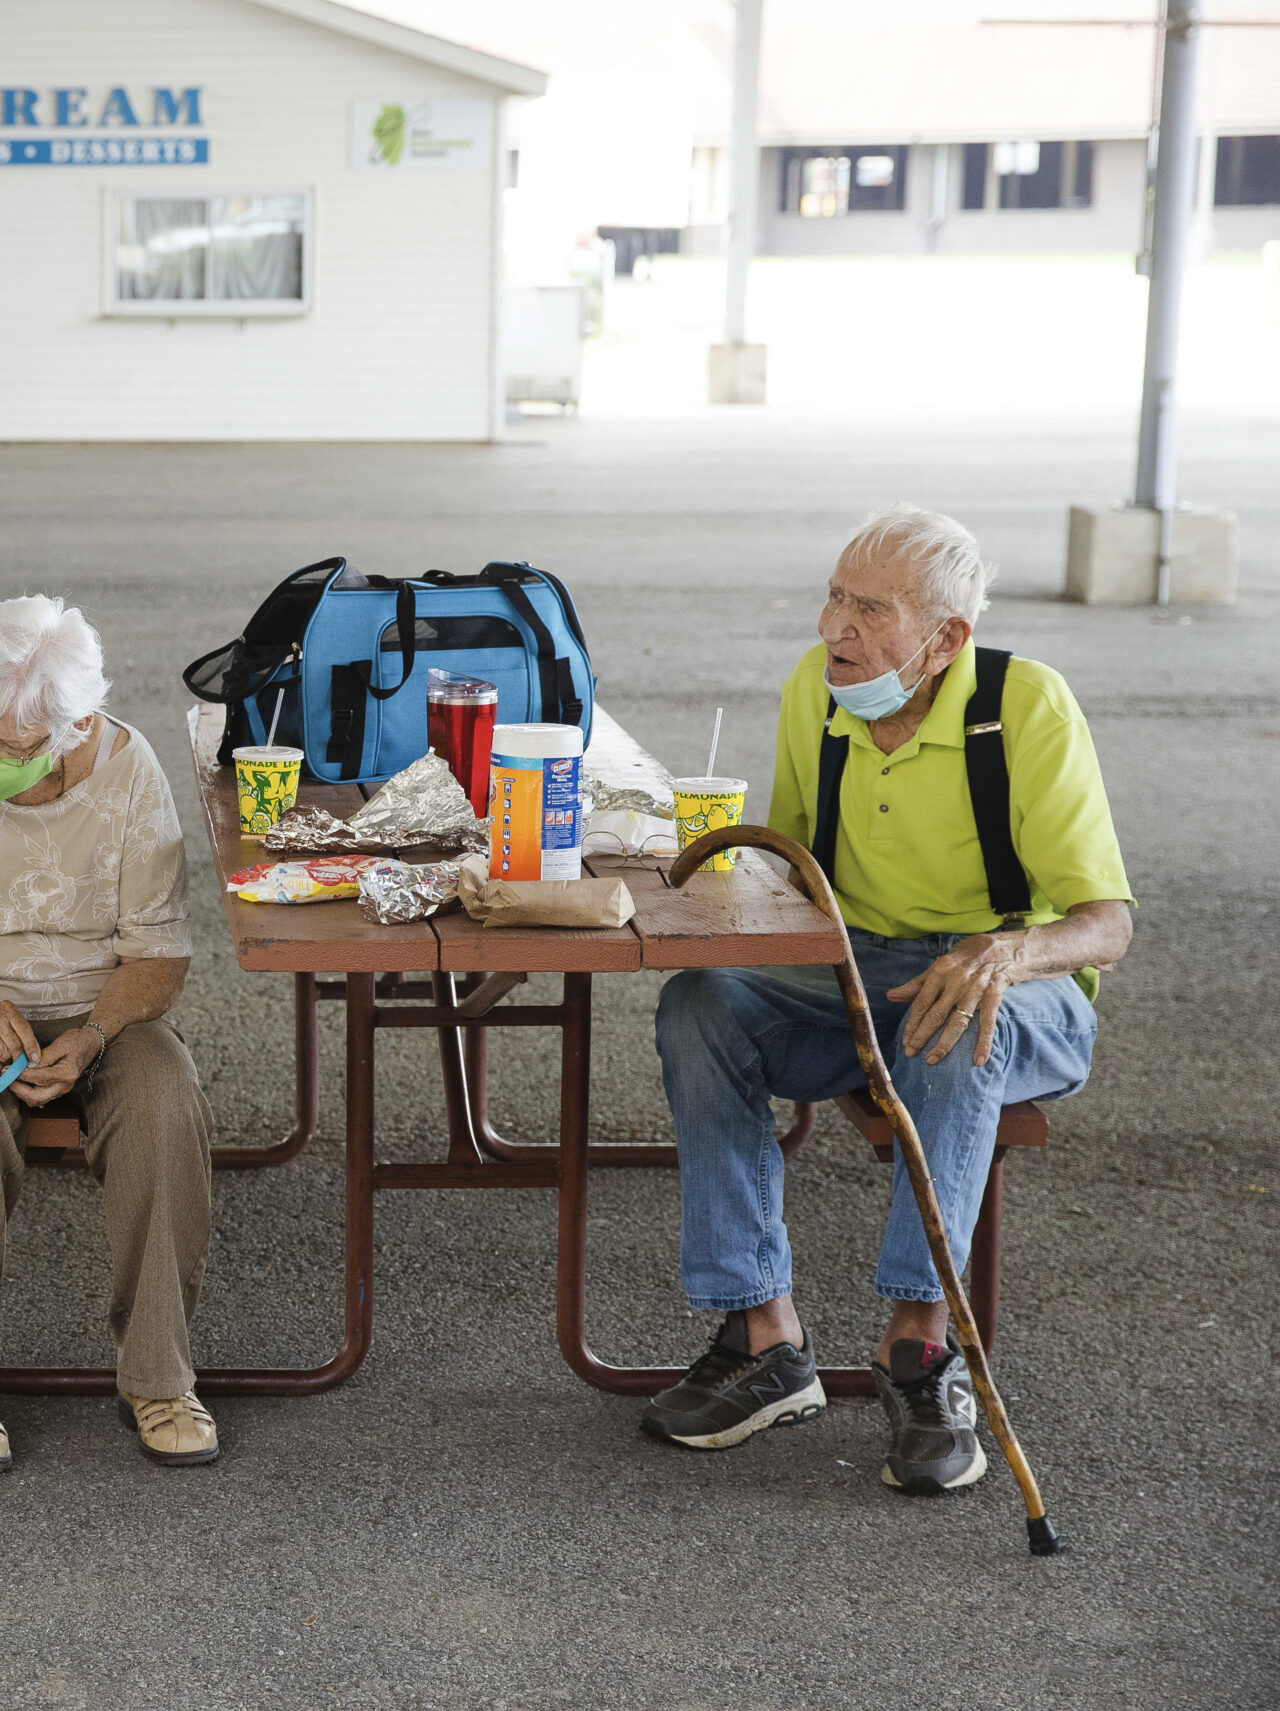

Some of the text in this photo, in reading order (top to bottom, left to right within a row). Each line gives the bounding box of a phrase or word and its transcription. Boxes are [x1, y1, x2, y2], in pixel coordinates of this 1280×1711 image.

[50, 140, 197, 162] DESSERTS
[236, 759, 278, 768] MONADE
[679, 791, 737, 800] LEMONADE
